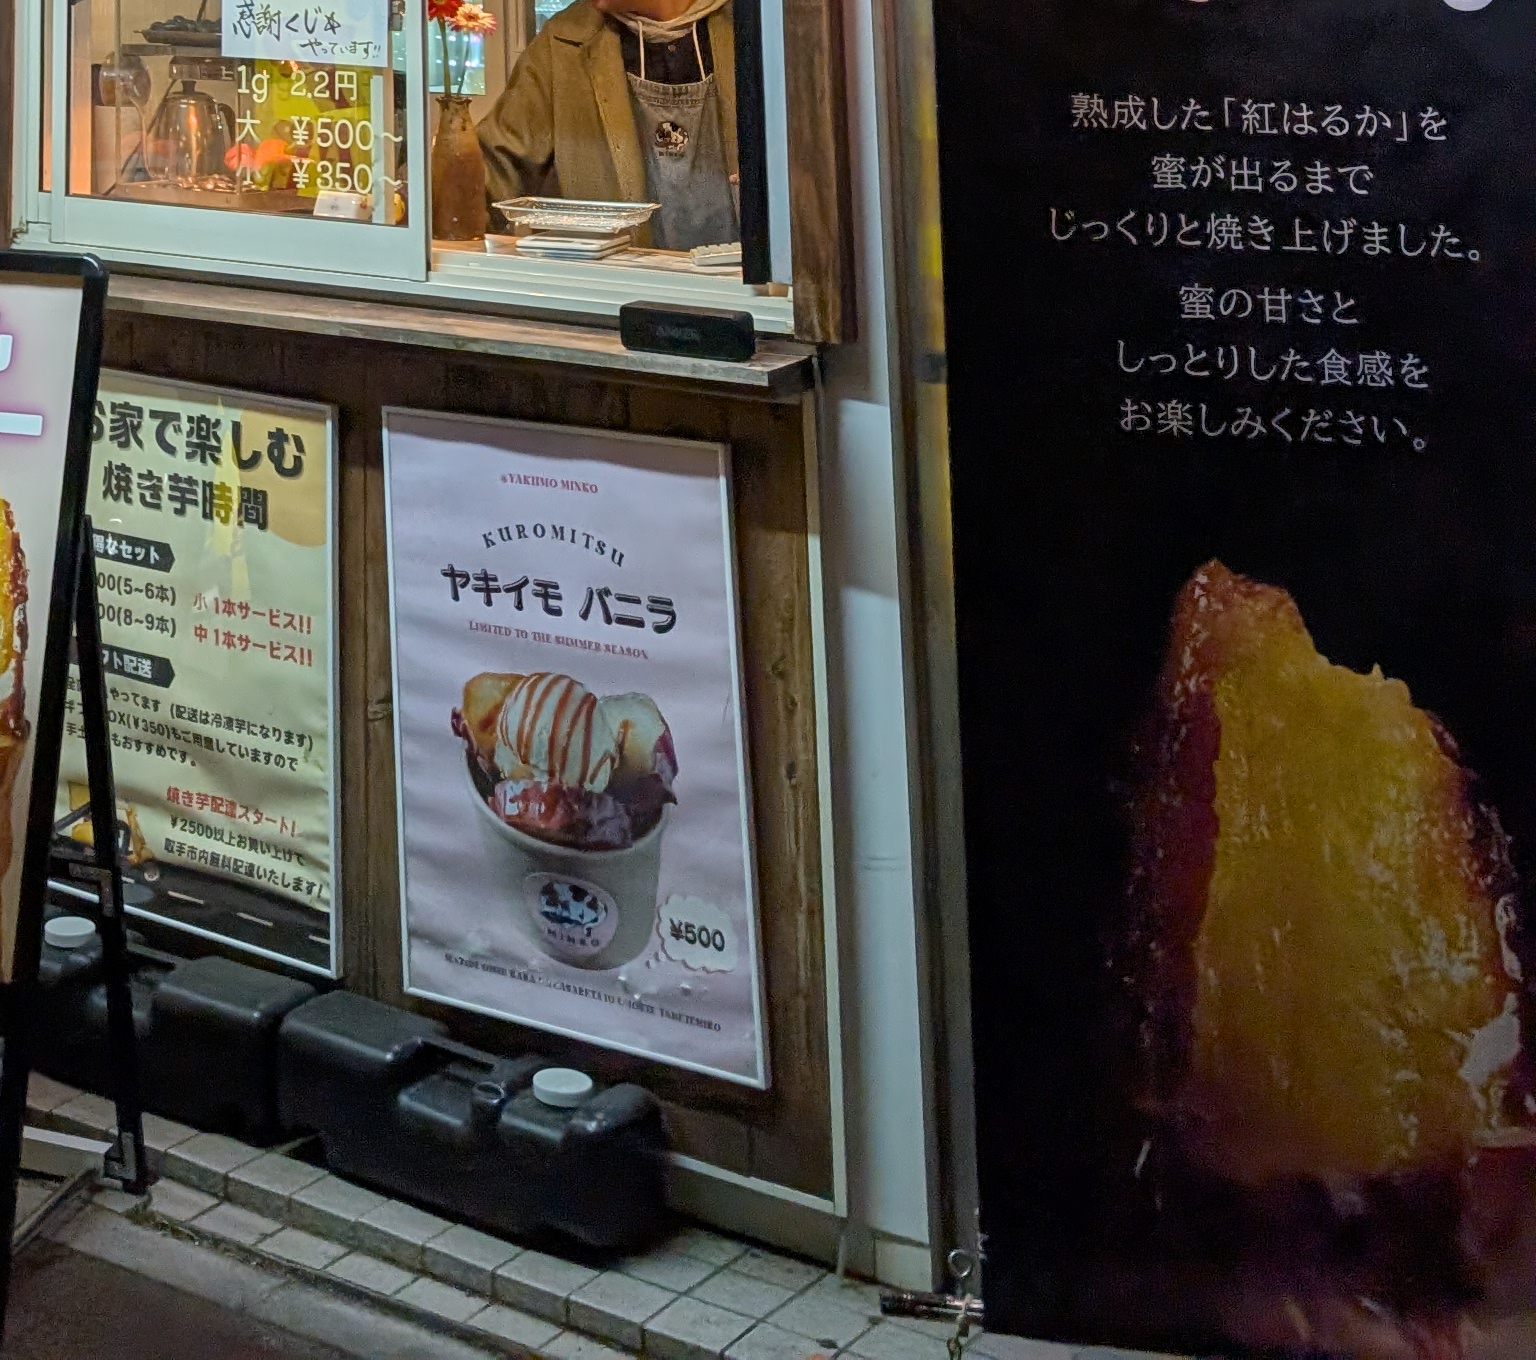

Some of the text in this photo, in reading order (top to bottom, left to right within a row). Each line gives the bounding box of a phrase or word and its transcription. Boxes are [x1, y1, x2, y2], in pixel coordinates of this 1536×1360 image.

[237, 65, 271, 103] 1g
[290, 69, 358, 101] 2.2円
[236, 110, 262, 145] 大
[1070, 92, 1449, 144] 熟成した「紅はるか」を
[1151, 154, 1376, 198] 蜜が出るまで
[1049, 207, 1483, 265] じっくりと焼き上げました。
[1178, 282, 1362, 325] 蜜の甘さと
[1117, 338, 1430, 389] しっとりした食感を
[1119, 399, 1427, 453] お楽しみください。
[103, 461, 268, 531] 焼き芋時間
[482, 523, 624, 567] KUROMITSU
[440, 563, 677, 634] ヤキイモ バニラ
[669, 918, 725, 952] ¥500
